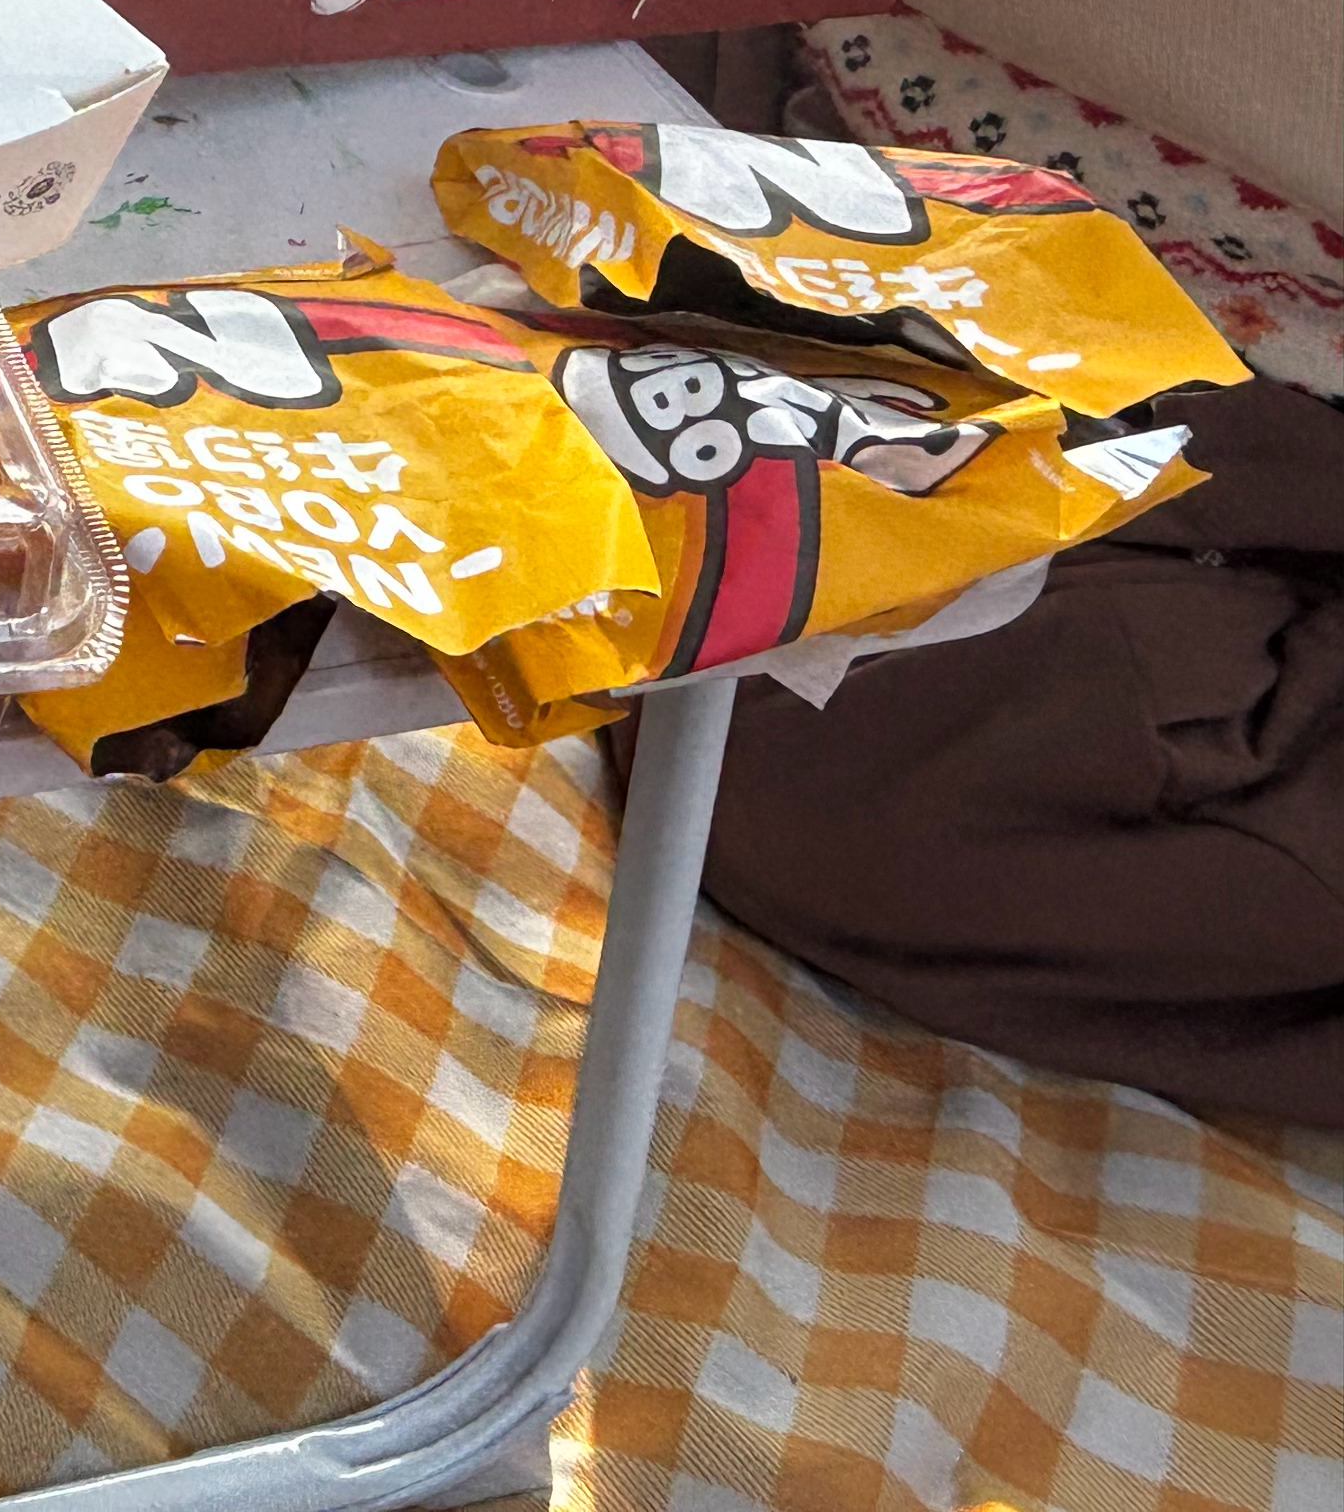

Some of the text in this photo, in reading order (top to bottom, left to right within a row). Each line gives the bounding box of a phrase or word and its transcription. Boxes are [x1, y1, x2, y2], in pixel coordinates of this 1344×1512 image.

[70, 409, 409, 494] 牛约堡
[122, 474, 446, 554] YOBO
[186, 510, 445, 616] NEW
